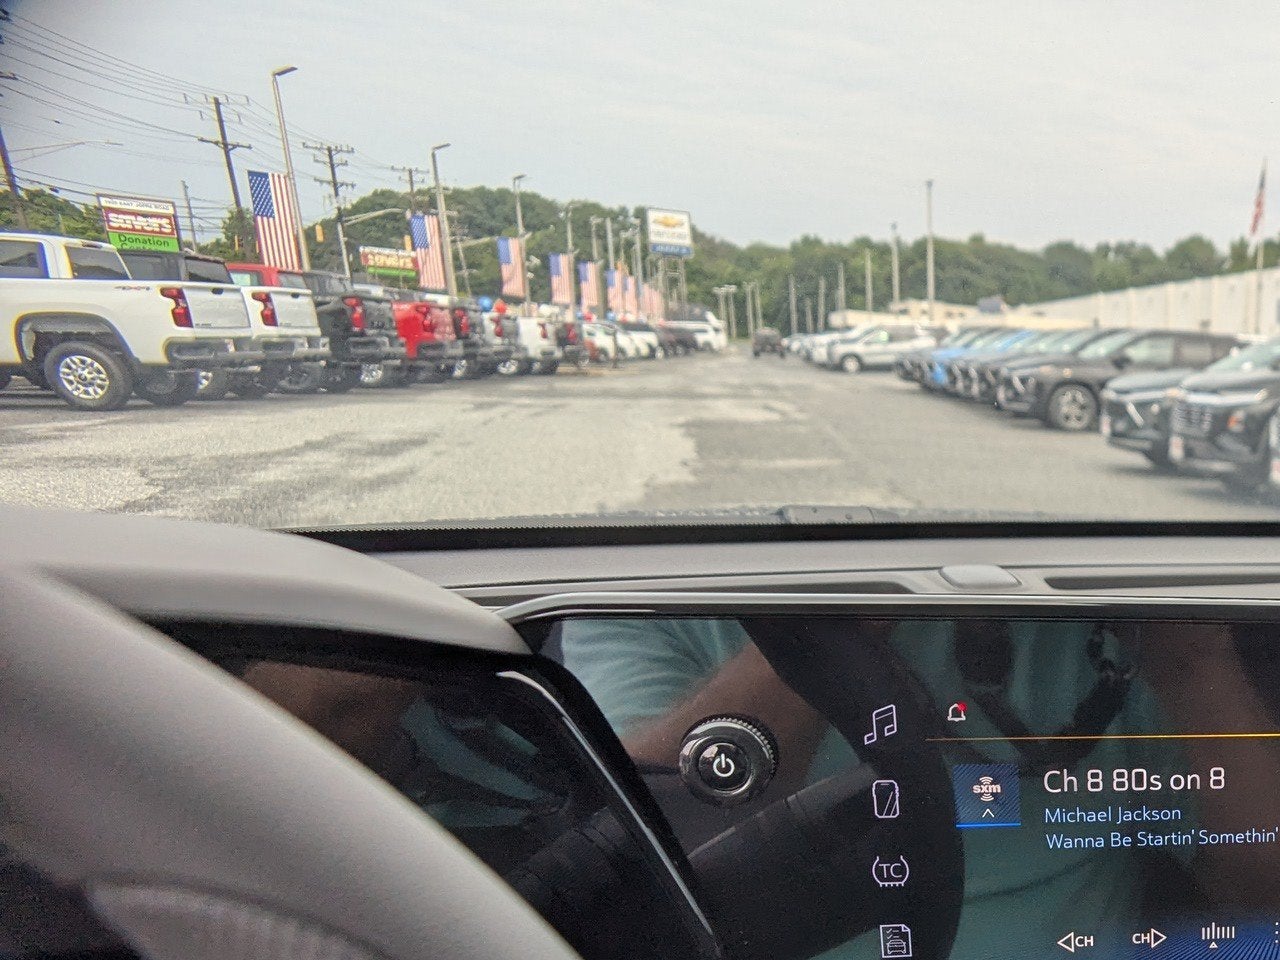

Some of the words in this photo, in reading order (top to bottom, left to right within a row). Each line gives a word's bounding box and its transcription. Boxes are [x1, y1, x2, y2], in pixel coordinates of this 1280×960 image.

[118, 233, 169, 247] Donation
[1043, 768, 1078, 793] Ch
[1087, 769, 1103, 792] 8
[1112, 768, 1162, 792] 80s
[1169, 772, 1200, 790] on
[1209, 766, 1225, 790] 8
[1045, 805, 1112, 823] Michael
[1116, 805, 1182, 824] Jackson
[1045, 833, 1105, 849] Wanna
[1110, 832, 1132, 847] Be
[1137, 829, 1195, 846] Startin'
[1199, 827, 1279, 845] Somethin'
[878, 864, 903, 880] TC
[1075, 934, 1094, 948] CH
[1132, 931, 1152, 945] CH
